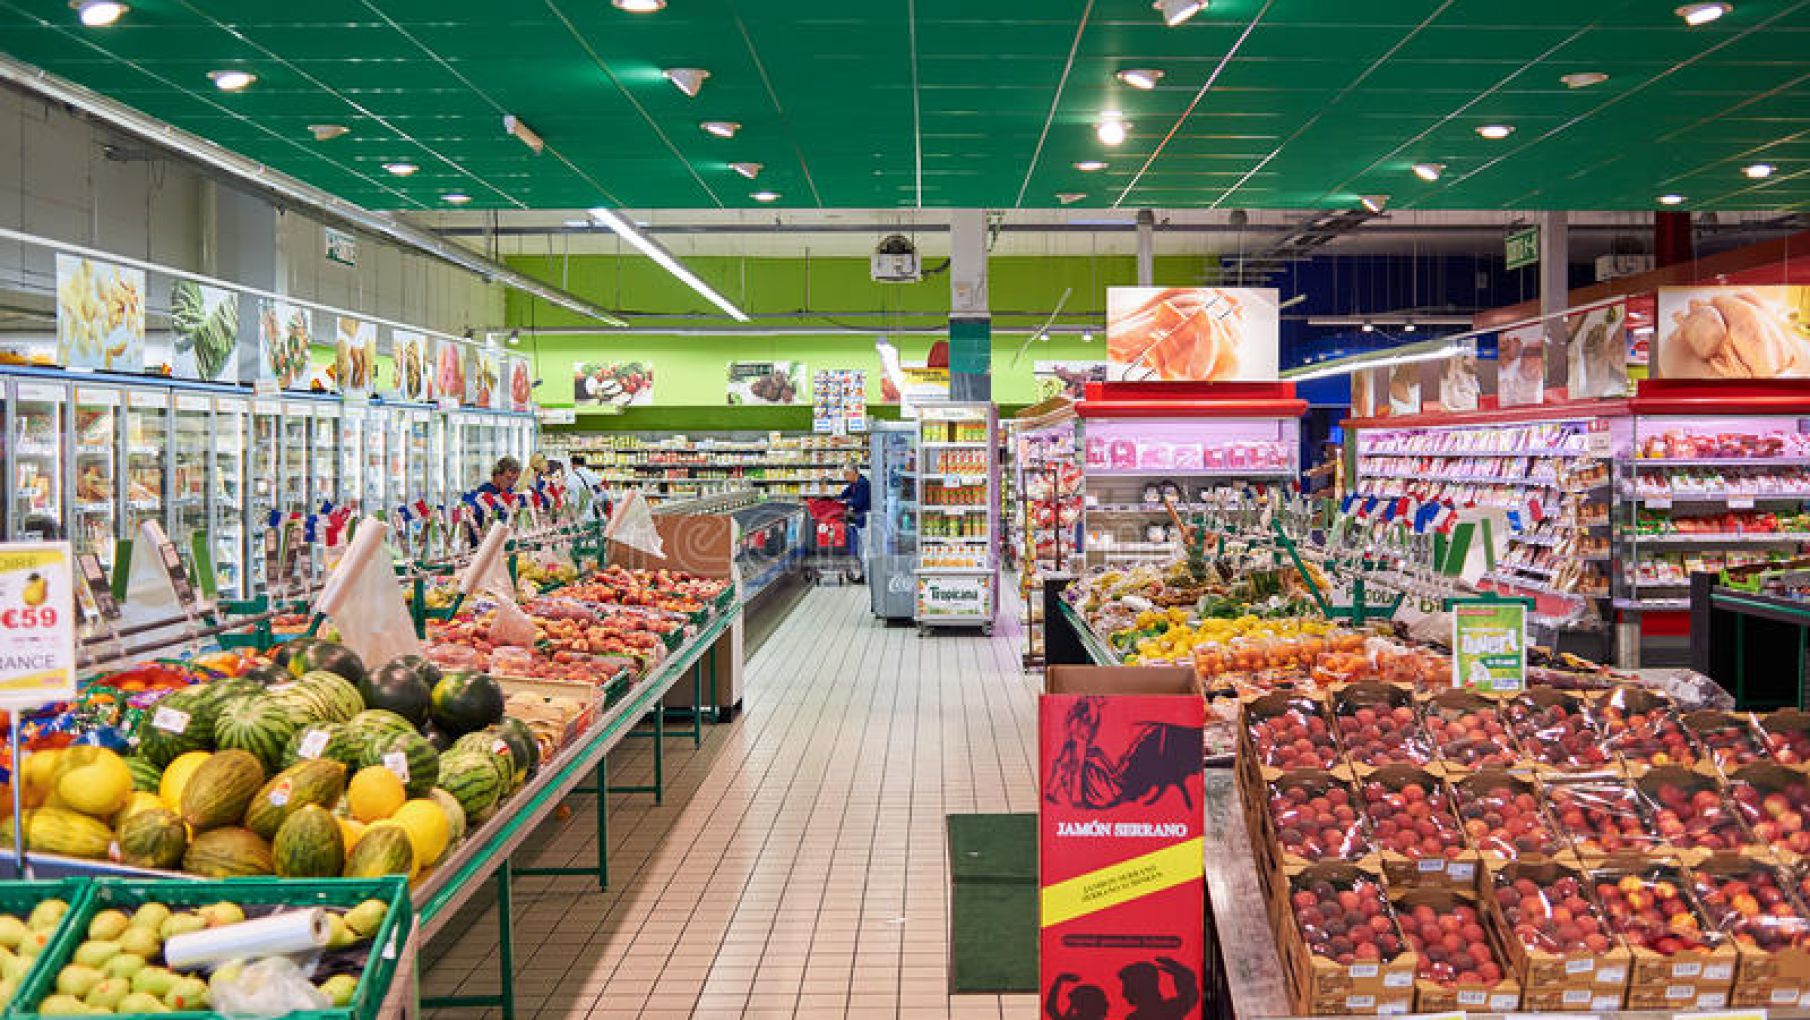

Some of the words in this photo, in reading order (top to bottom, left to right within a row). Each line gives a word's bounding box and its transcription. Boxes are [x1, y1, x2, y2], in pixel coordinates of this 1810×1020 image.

[930, 586, 978, 601] Tropicana
[1056, 821, 1110, 836] JAMÓN
[1115, 824, 1188, 837] SERRANO
